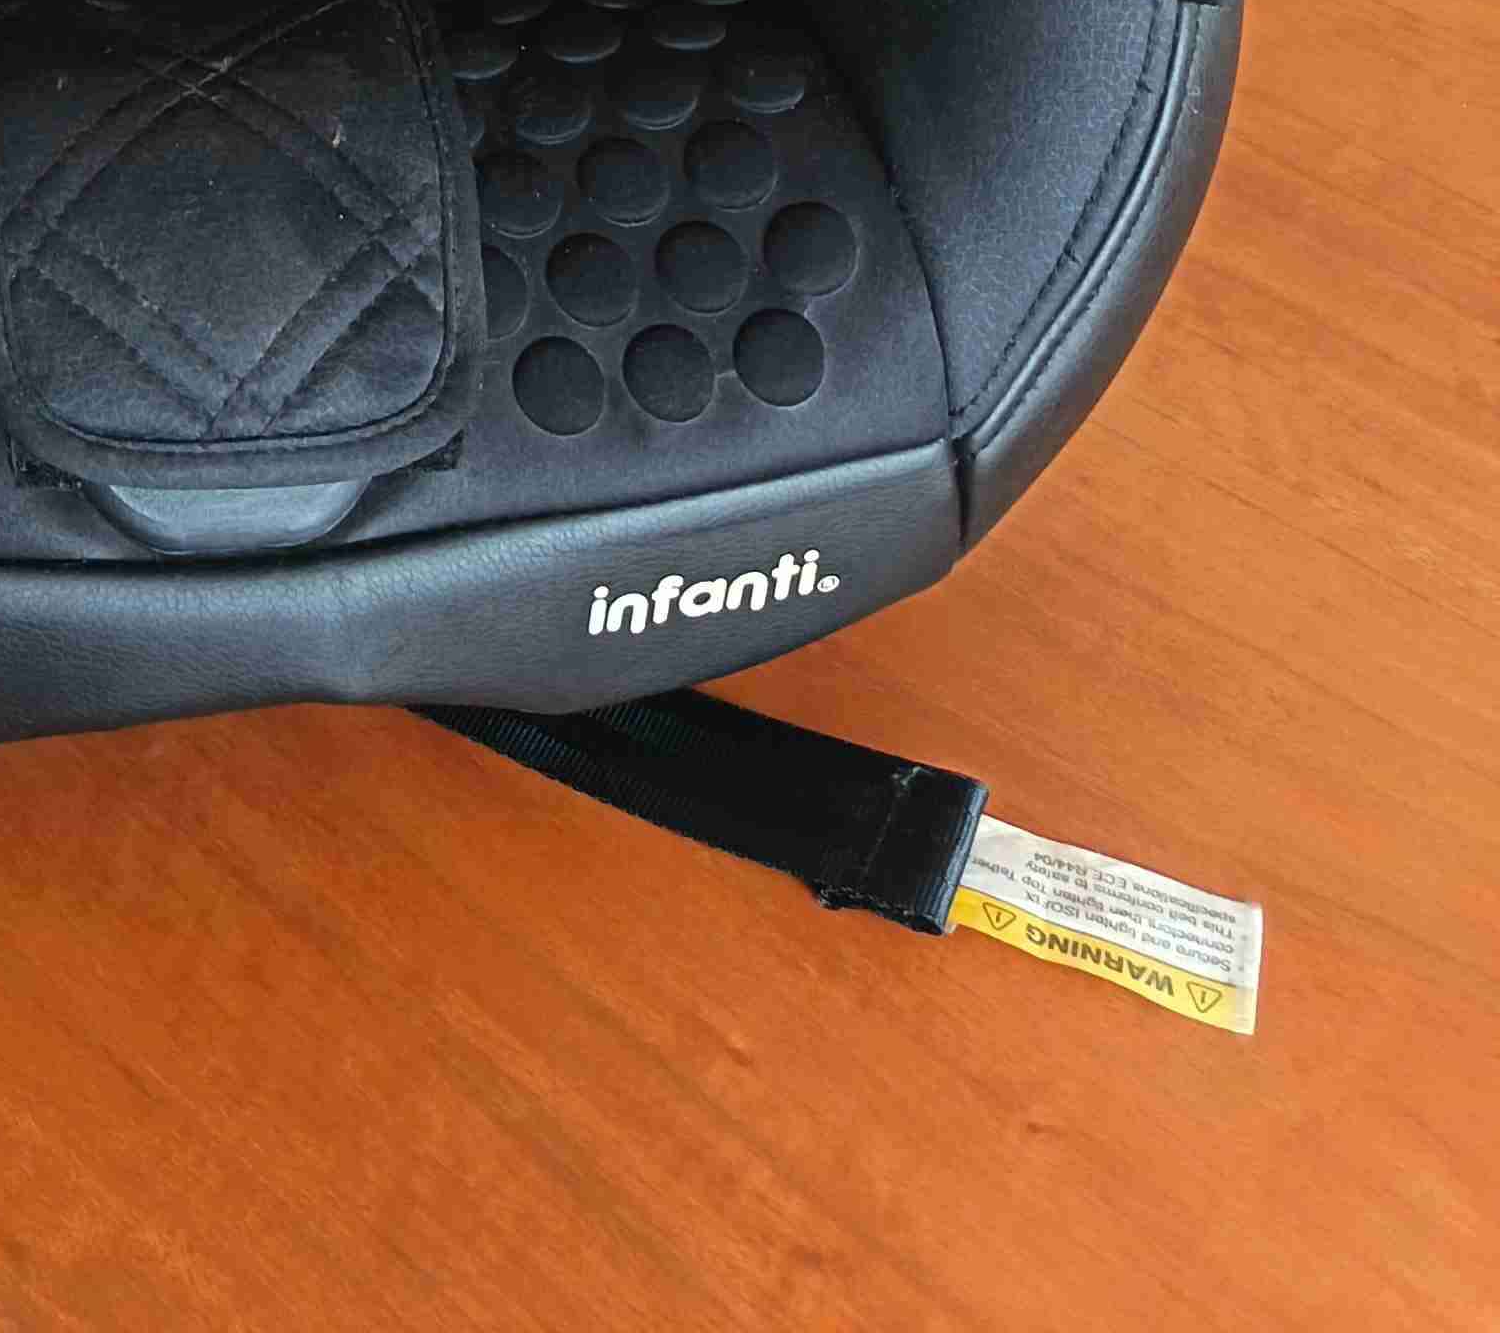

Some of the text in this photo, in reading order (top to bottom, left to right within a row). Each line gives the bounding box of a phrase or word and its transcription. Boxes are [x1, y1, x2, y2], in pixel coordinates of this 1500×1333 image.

[972, 857, 1015, 881] Tether
[1026, 860, 1070, 882] safety
[1093, 869, 1127, 889] ECE
[1021, 875, 1046, 893] Top
[1075, 877, 1088, 890] to
[1052, 888, 1104, 911] tighten
[1093, 884, 1164, 914] conforms
[1132, 882, 1236, 923] specifications
[1085, 912, 1136, 938] tighten
[1109, 907, 1142, 925] then
[1141, 932, 1171, 949] and
[1203, 921, 1234, 940] This
[1026, 923, 1174, 996] WARNING
[1176, 944, 1231, 972] Secure
